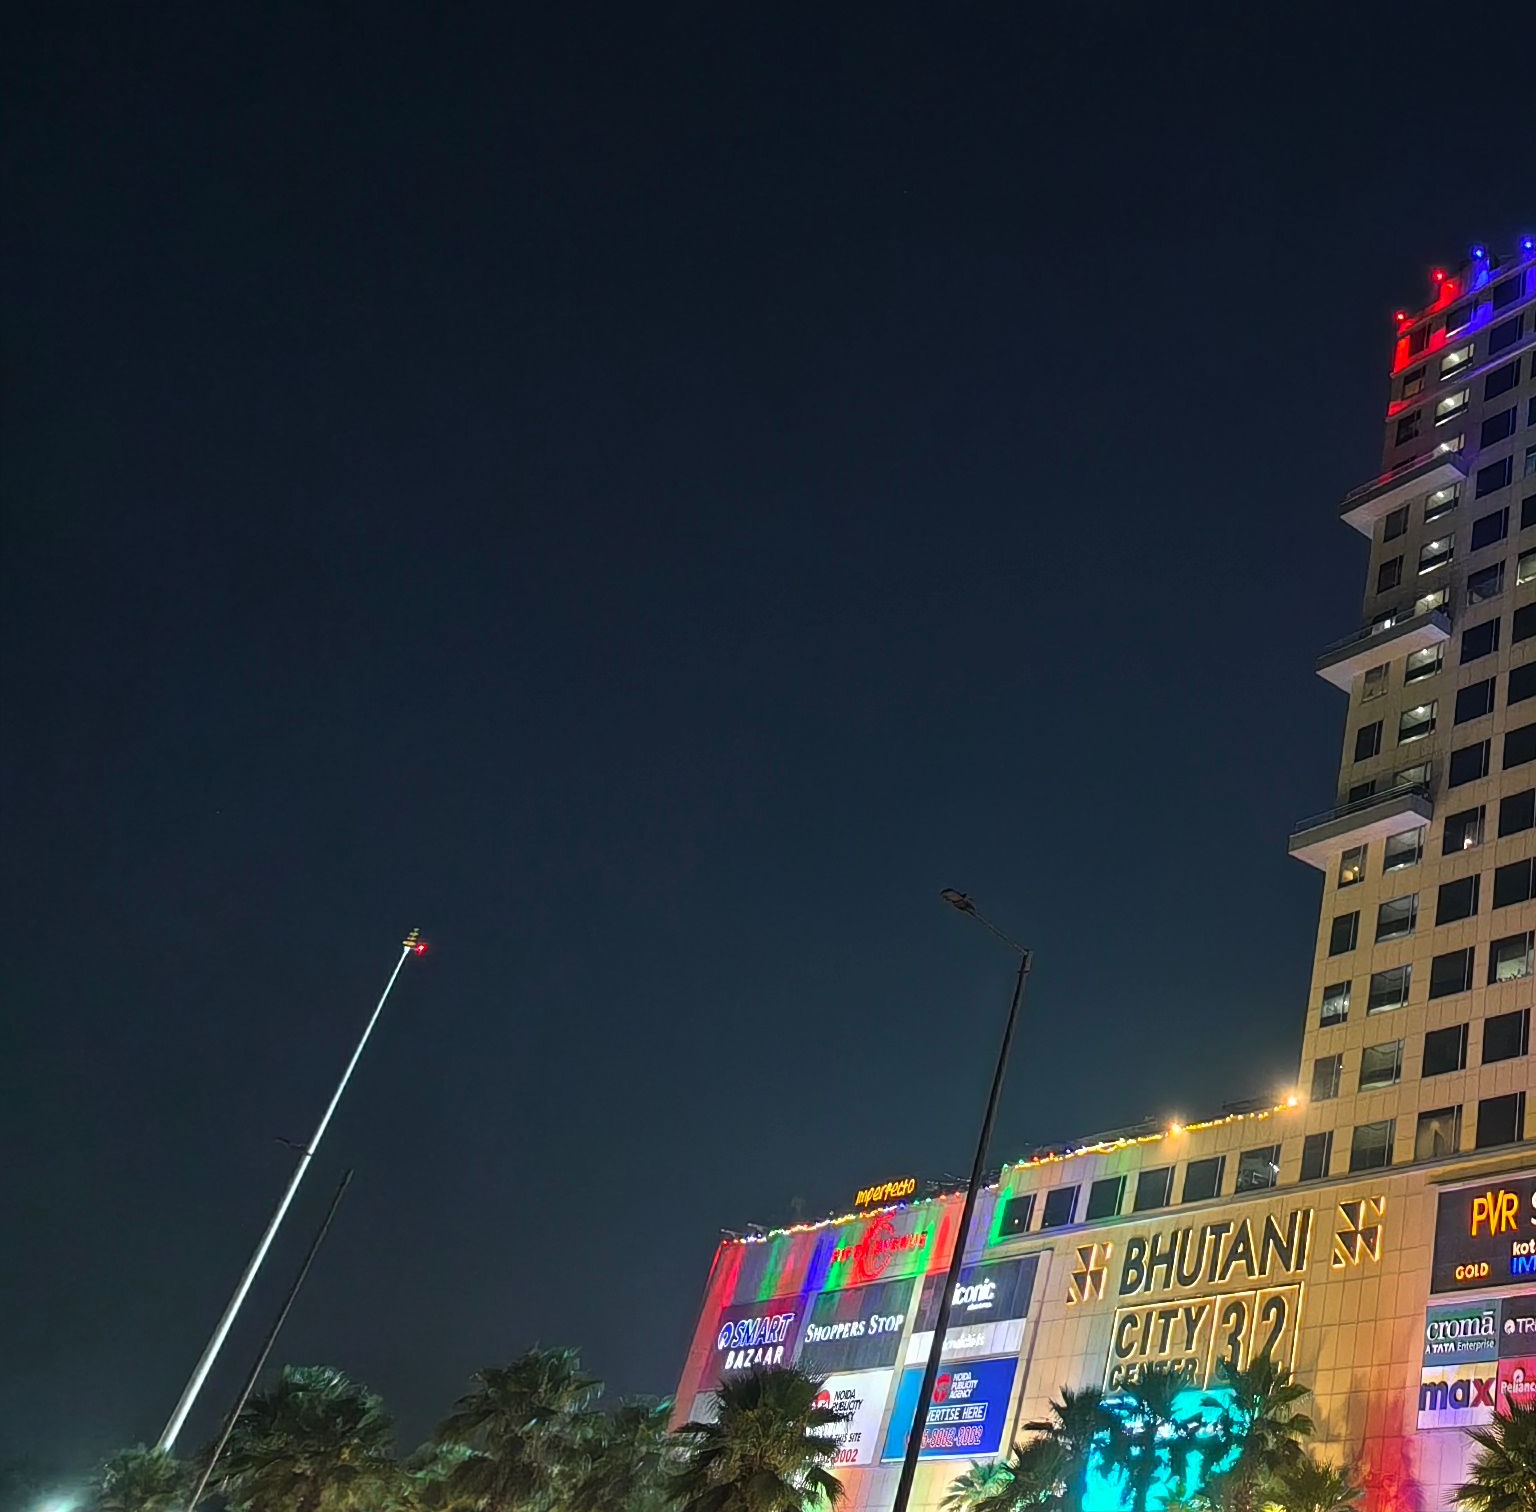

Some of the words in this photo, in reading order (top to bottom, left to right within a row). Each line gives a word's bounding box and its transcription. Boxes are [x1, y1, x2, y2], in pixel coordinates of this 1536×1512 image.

[1471, 1190, 1519, 1236] PVR
[1118, 1208, 1314, 1296] BHUTANI
[1455, 1262, 1489, 1280] GOLD
[952, 1277, 996, 1305] iconic
[732, 1314, 795, 1348] SMART
[805, 1320, 865, 1342] SHOPPERS
[868, 1315, 904, 1335] STOP
[1116, 1305, 1210, 1359] CITY
[725, 1346, 784, 1369] BAZAAR
[1425, 1345, 1431, 1354] A
[1432, 1343, 1455, 1353] TATA
[1457, 1339, 1495, 1351] Enterprise
[834, 1389, 856, 1401] NOIDA
[1419, 1377, 1496, 1410] max
[926, 1408, 960, 1421] VERTISE
[962, 1406, 984, 1420] HERE
[848, 1432, 862, 1443] SITE
